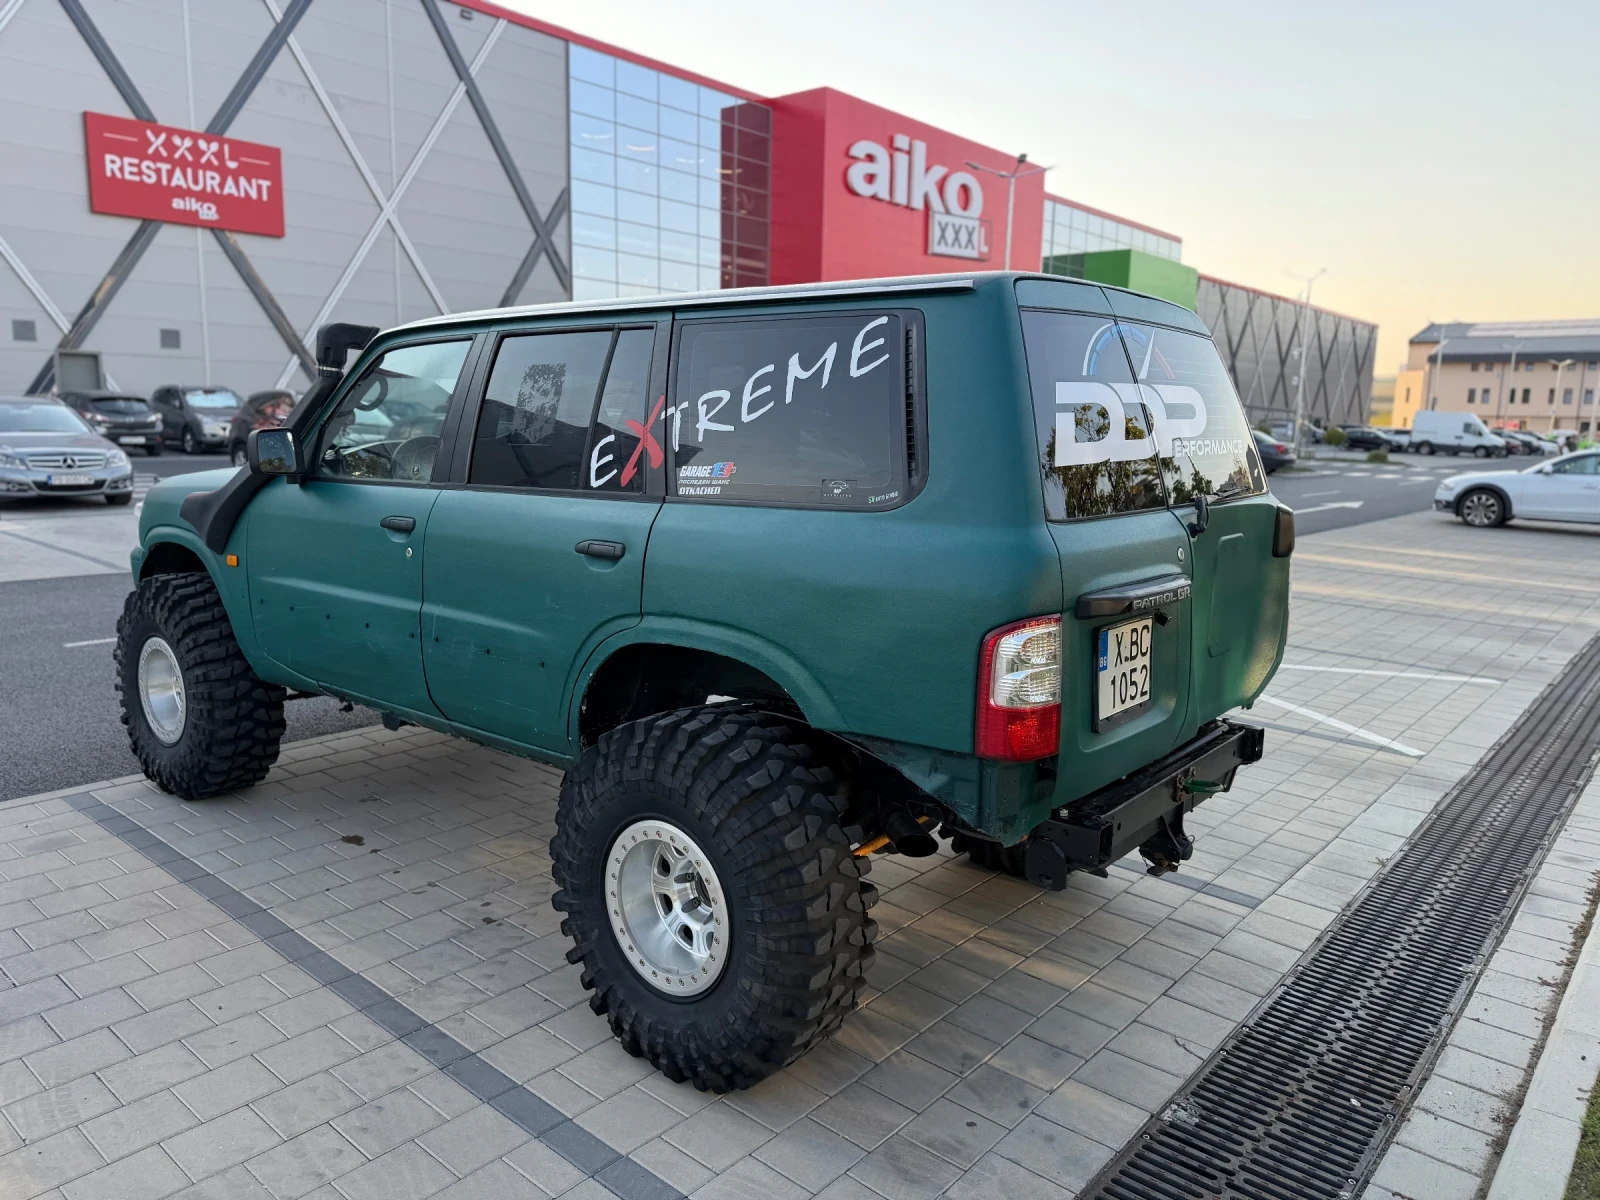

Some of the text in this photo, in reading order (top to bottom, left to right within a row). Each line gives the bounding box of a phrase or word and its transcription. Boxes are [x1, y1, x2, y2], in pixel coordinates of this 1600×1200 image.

[104, 153, 271, 202] RESTAURANT
[847, 133, 983, 219] aiko
[171, 196, 218, 214] aiko
[590, 316, 890, 488] EXTREME
[679, 465, 712, 478] GARAGE
[1133, 587, 1191, 610] PATROL GR
[1110, 664, 1148, 709] 1052
